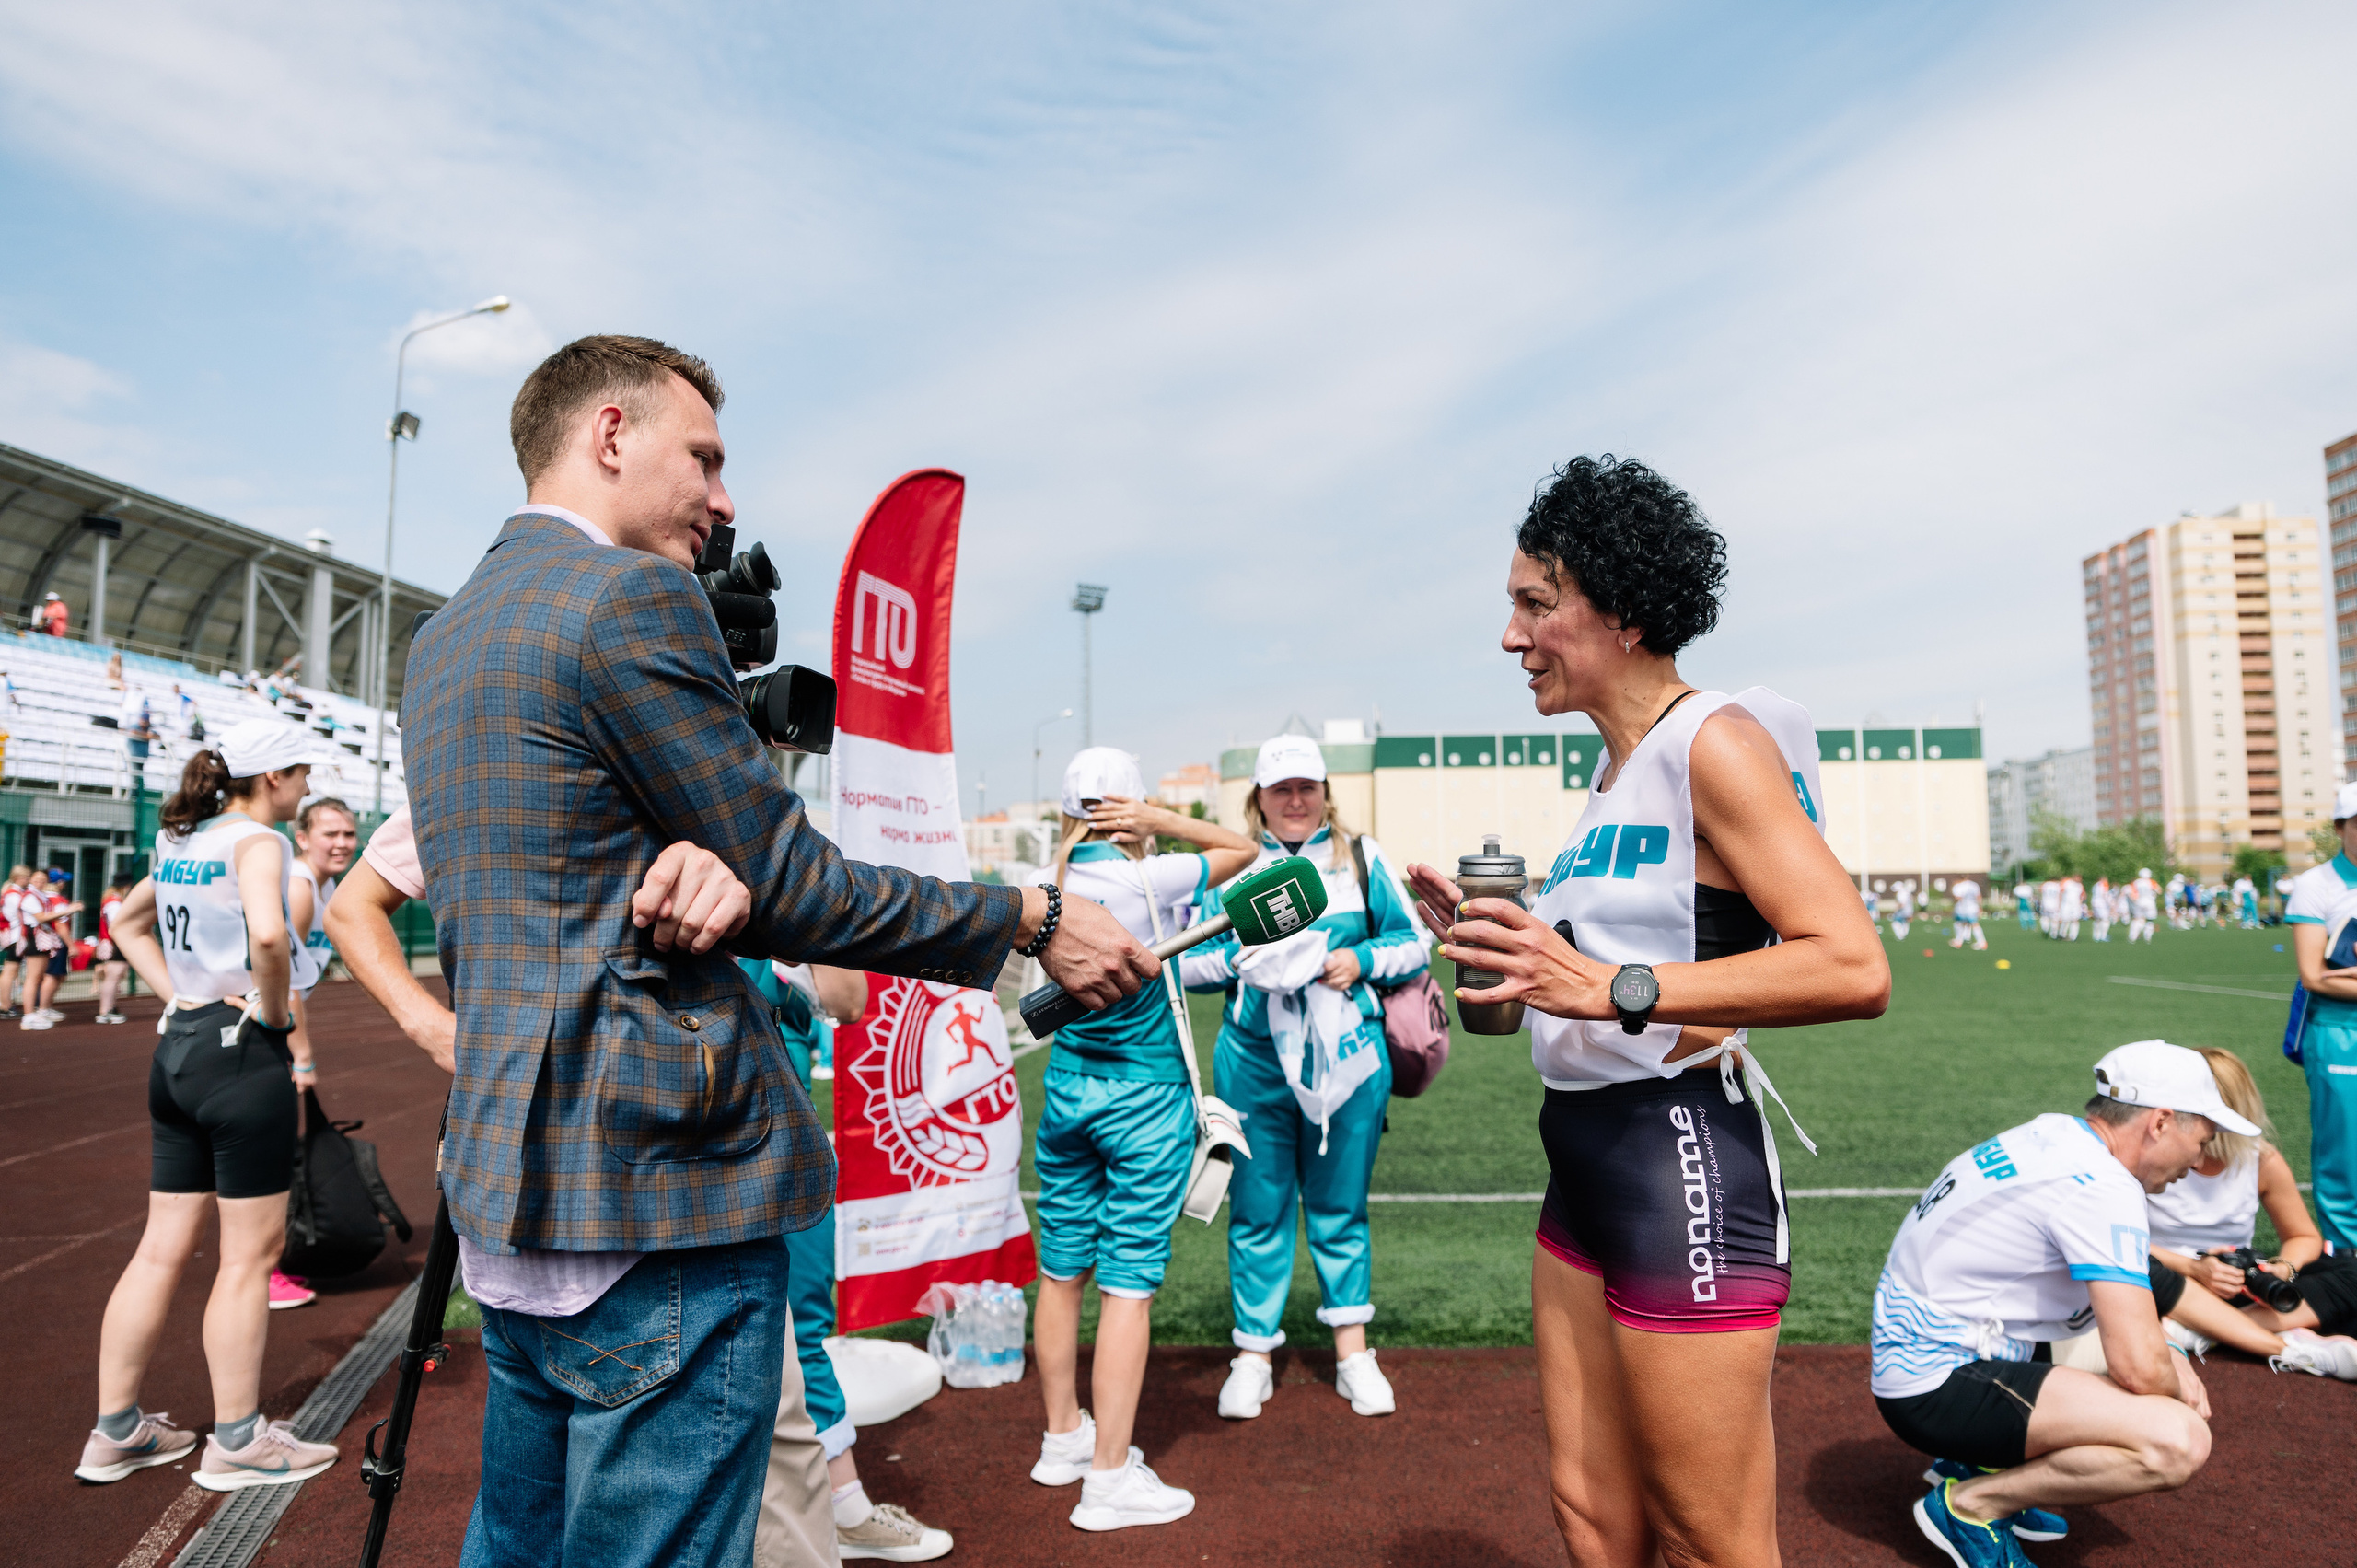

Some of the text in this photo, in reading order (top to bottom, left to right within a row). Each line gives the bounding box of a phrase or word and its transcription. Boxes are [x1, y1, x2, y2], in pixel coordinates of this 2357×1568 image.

[906, 796, 929, 815] ГТО
[1538, 824, 1670, 900] ИБУР
[166, 904, 192, 952] 92
[963, 1073, 1018, 1125] ГТО
[1669, 1105, 1717, 1302] noname
[1697, 1105, 1729, 1274] the choice of champions
[2110, 1224, 2150, 1267] ГТ
